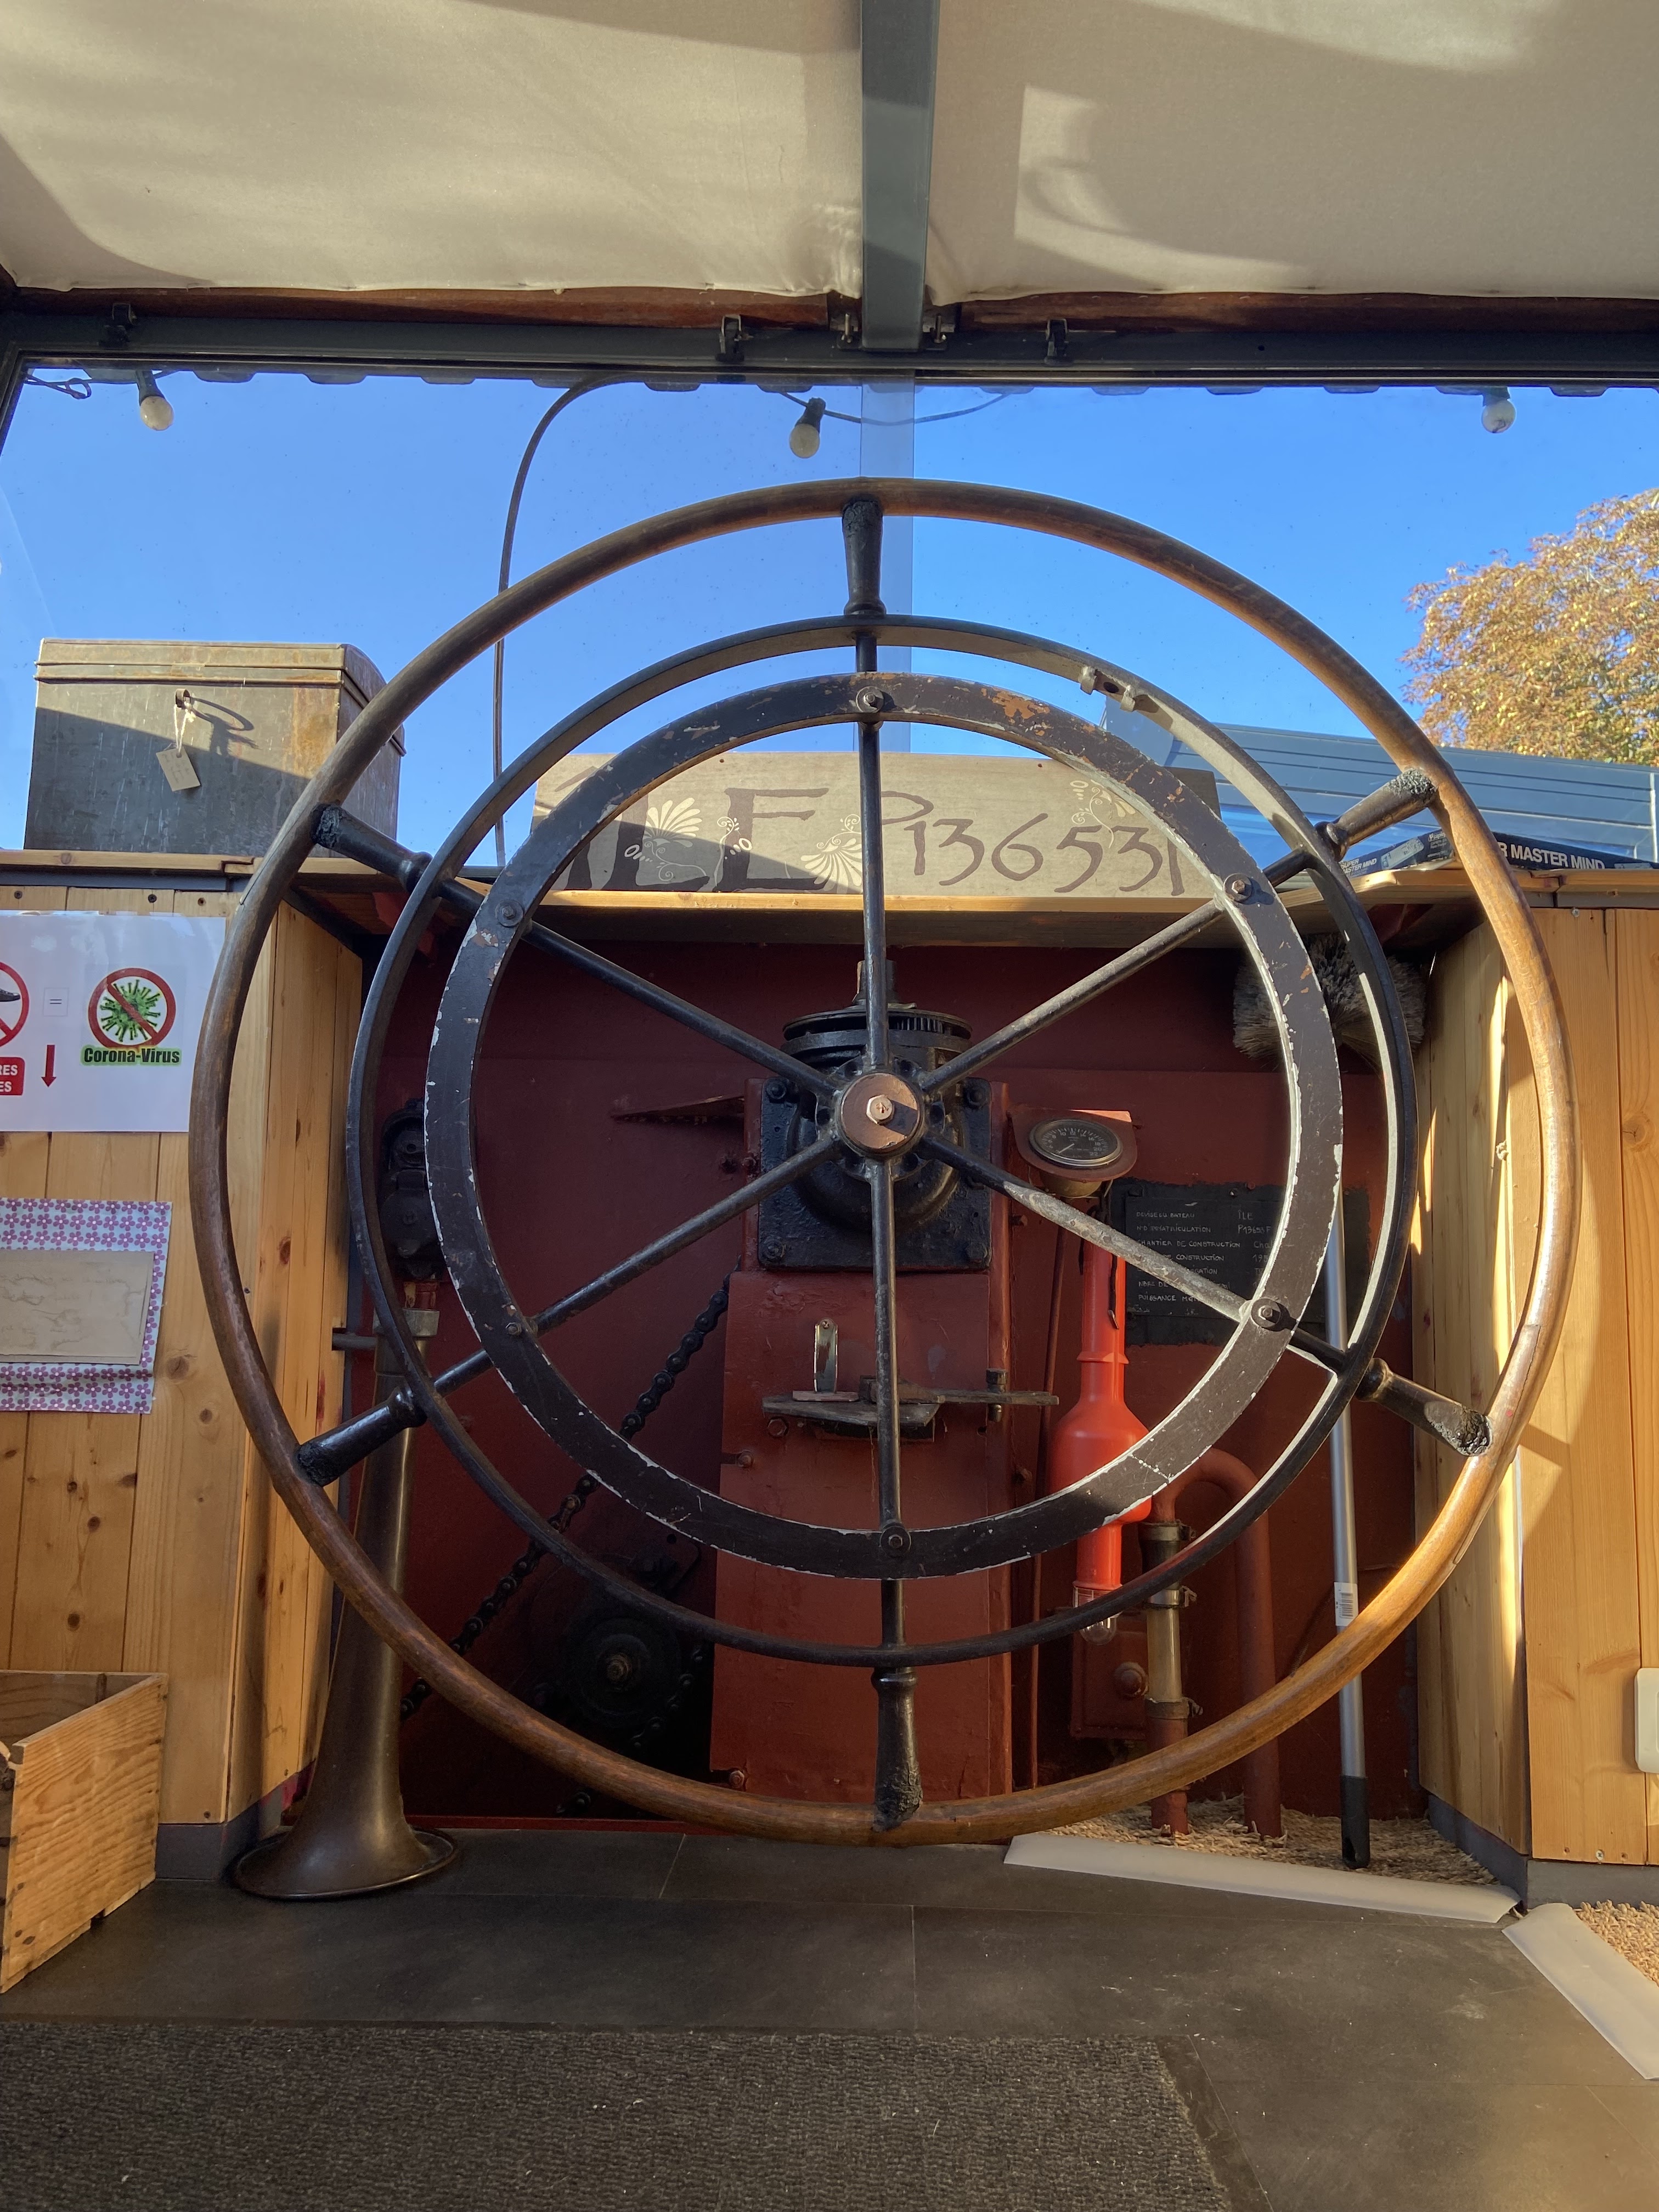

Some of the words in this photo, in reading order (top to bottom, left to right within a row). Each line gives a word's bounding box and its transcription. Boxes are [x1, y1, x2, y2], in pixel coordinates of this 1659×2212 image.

[1362, 858, 1377, 868] MIND
[1510, 844, 1568, 867] MASTER
[1570, 854, 1605, 869] MIND
[1340, 858, 1359, 870] SUPER
[84, 1047, 180, 1063] Corona-Virus
